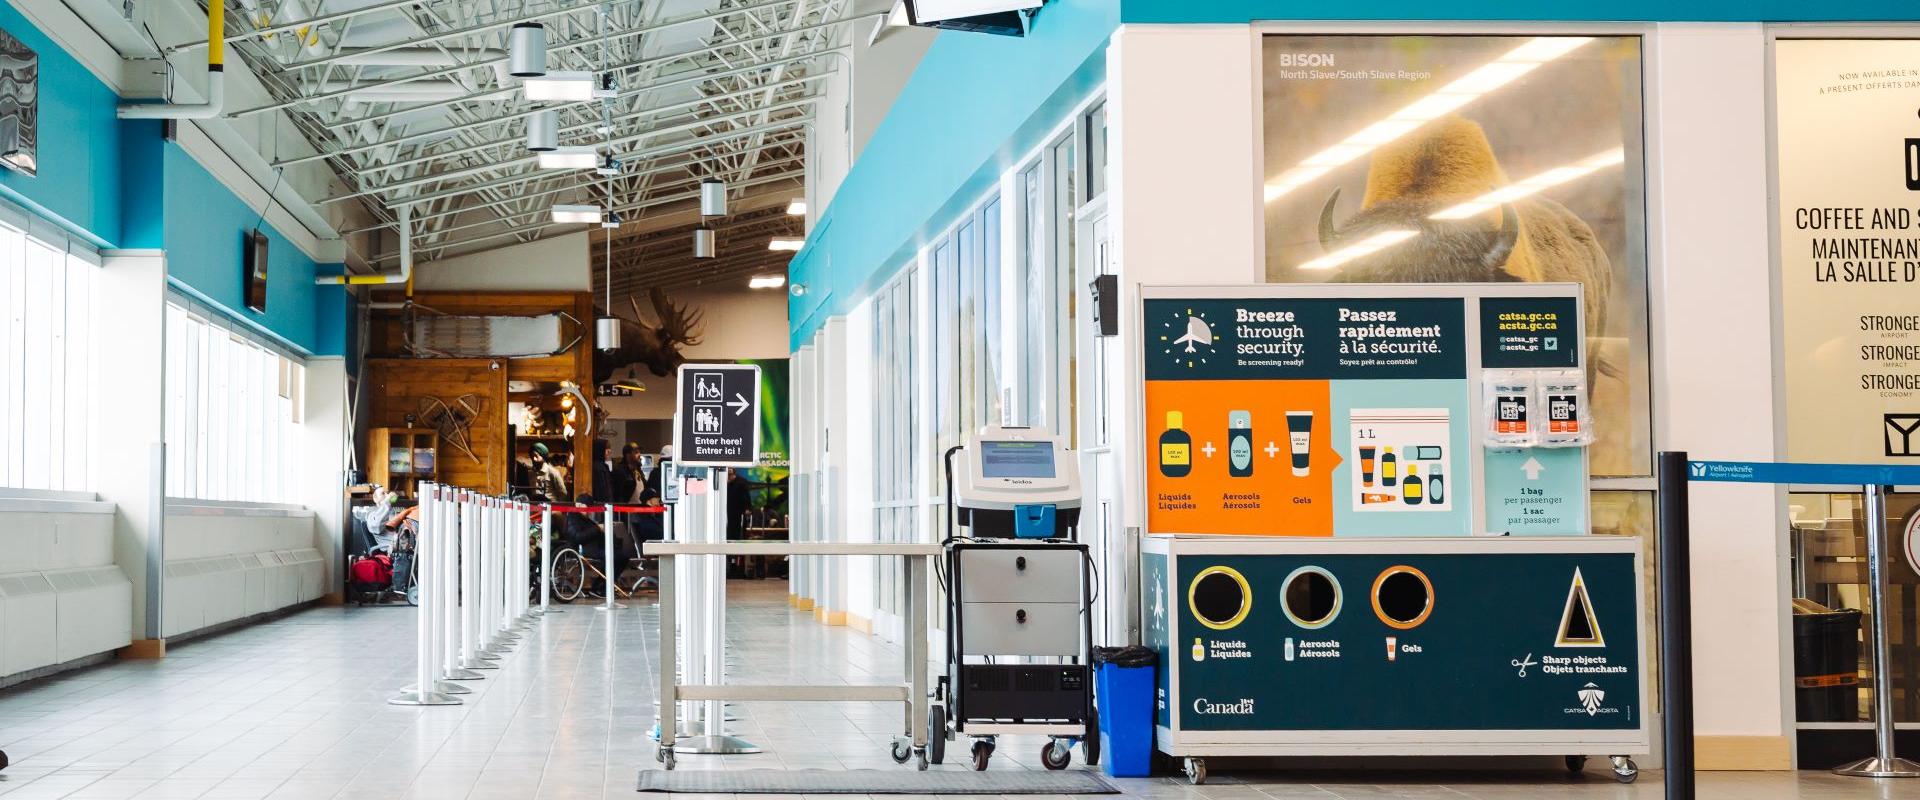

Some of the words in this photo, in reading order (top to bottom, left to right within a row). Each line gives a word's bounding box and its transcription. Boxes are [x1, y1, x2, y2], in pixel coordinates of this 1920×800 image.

[1280, 54, 1334, 67] BISON
[1280, 70, 1308, 79] North
[1310, 70, 1368, 79] Slave/South
[1370, 70, 1396, 79] Slave
[1398, 70, 1431, 80] Region
[1839, 72, 1859, 80] NOW
[1862, 70, 1907, 78] AVAILABLE
[1796, 208, 1864, 230] COFFEE
[1871, 208, 1910, 230] AND
[1812, 238, 1920, 259] MAINTENAN
[1816, 261, 1837, 282] LA
[1843, 261, 1897, 282] SALLE
[1904, 261, 1920, 282] D'
[1236, 308, 1295, 322] Breeze
[1338, 308, 1397, 321] Passez
[1499, 312, 1557, 322] catsa.gc.ca
[1499, 322, 1557, 331] acsta.gc.ca
[1860, 316, 1920, 331] STRONGE
[1236, 324, 1305, 341] through
[1339, 323, 1441, 340] rapidement
[1236, 341, 1305, 357] security.
[1339, 340, 1349, 353] à
[1352, 340, 1367, 353] la
[1370, 339, 1442, 353] sécurité.
[1861, 345, 1920, 360] STRONGE
[1248, 359, 1282, 367] screening
[1361, 358, 1375, 366] prêt
[1861, 374, 1920, 389] STRONGE
[1358, 428, 1366, 439] 1
[1368, 428, 1376, 439] L
[695, 437, 719, 445] Enter
[720, 437, 743, 446] here!
[696, 447, 722, 455] Entrer
[725, 447, 736, 455] ici
[759, 451, 782, 459] RCTIC
[1709, 464, 1753, 473] Yellowknife
[1520, 487, 1526, 495] 1
[1527, 487, 1544, 496] bag
[1158, 493, 1192, 501] Liquids
[1292, 496, 1312, 504] Gels
[1504, 497, 1518, 505] per
[1520, 497, 1562, 505] passenger
[1158, 502, 1197, 511] Liquides
[1223, 501, 1261, 509] Aérosols
[1523, 507, 1528, 515] 1
[1508, 517, 1521, 525] par
[1524, 517, 1560, 525] passager
[1210, 640, 1247, 649] Liquids
[1299, 639, 1340, 648] Aerosols
[1402, 644, 1423, 653] Gels
[1210, 649, 1252, 659] Liquides
[1299, 649, 1340, 658] Aérosols
[1542, 655, 1572, 665] Sharp
[1573, 655, 1607, 665] objects
[1542, 665, 1574, 675] Objets
[1575, 665, 1628, 673] tranchants
[1193, 698, 1255, 715] Canada
